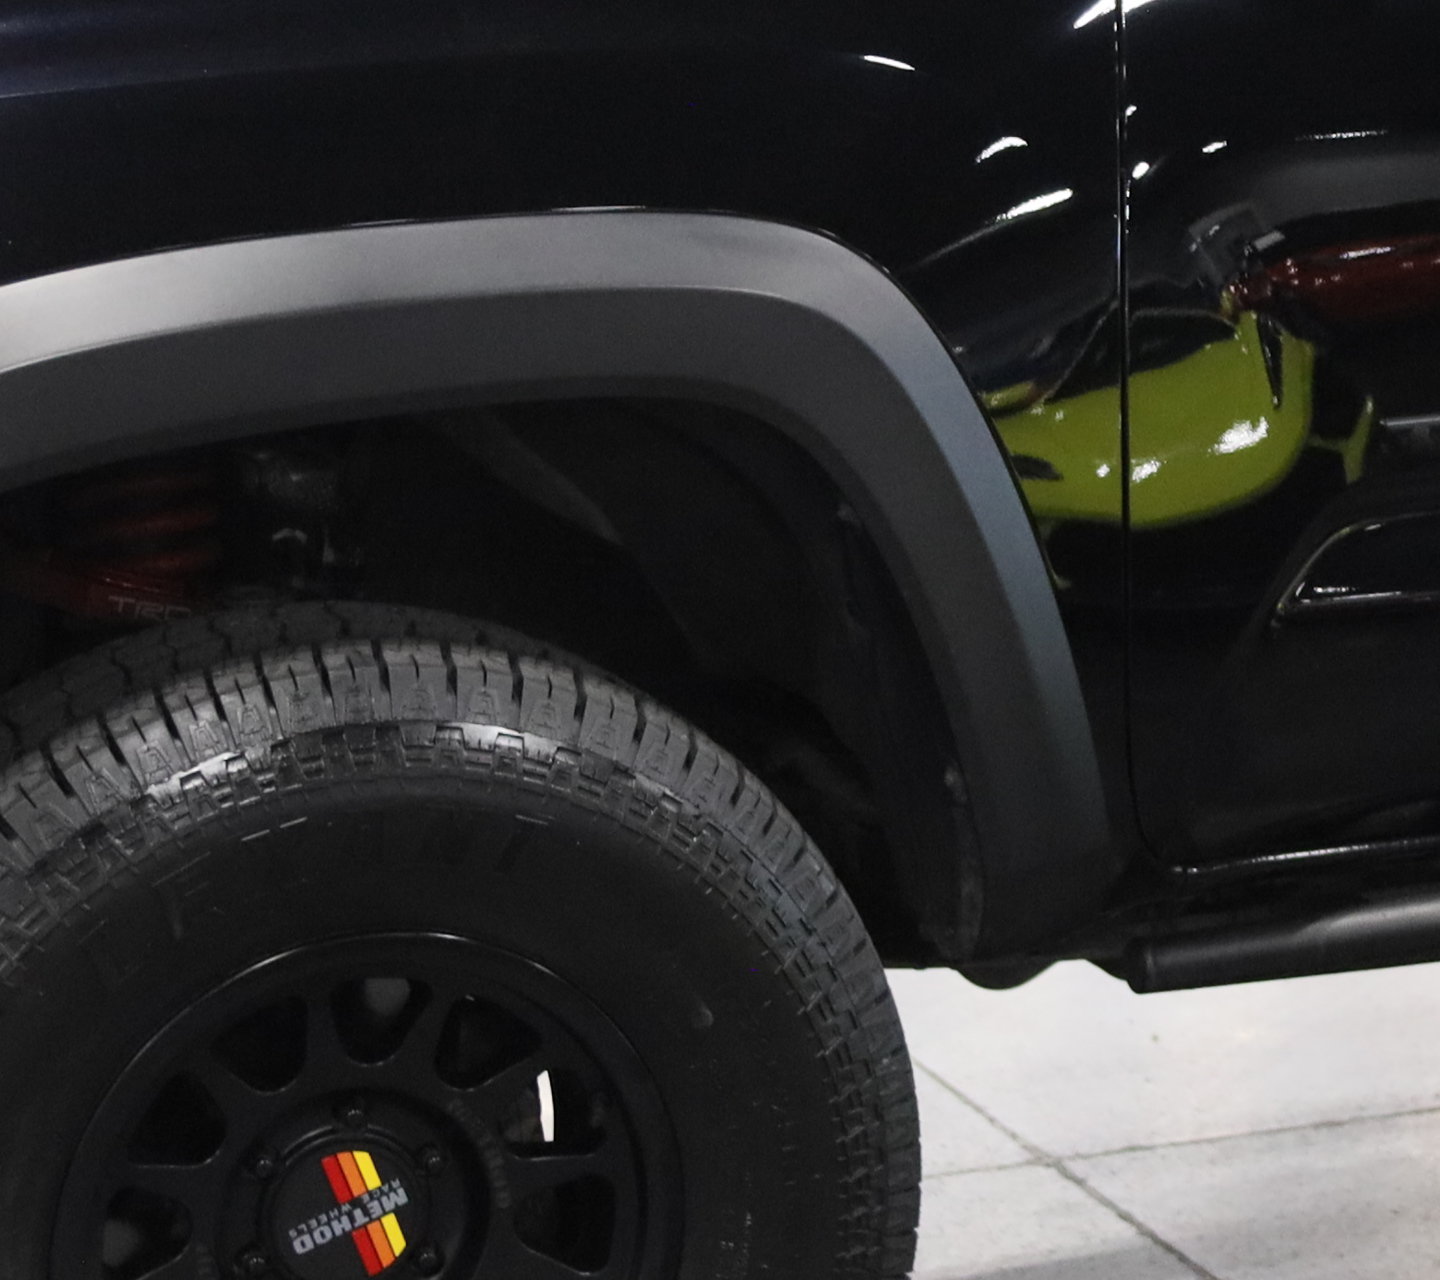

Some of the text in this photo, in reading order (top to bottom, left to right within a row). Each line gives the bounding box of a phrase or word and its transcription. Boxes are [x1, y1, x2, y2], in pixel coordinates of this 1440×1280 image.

[288, 1177, 401, 1239] RACE WHEELS
[292, 1187, 409, 1256] METHOD
